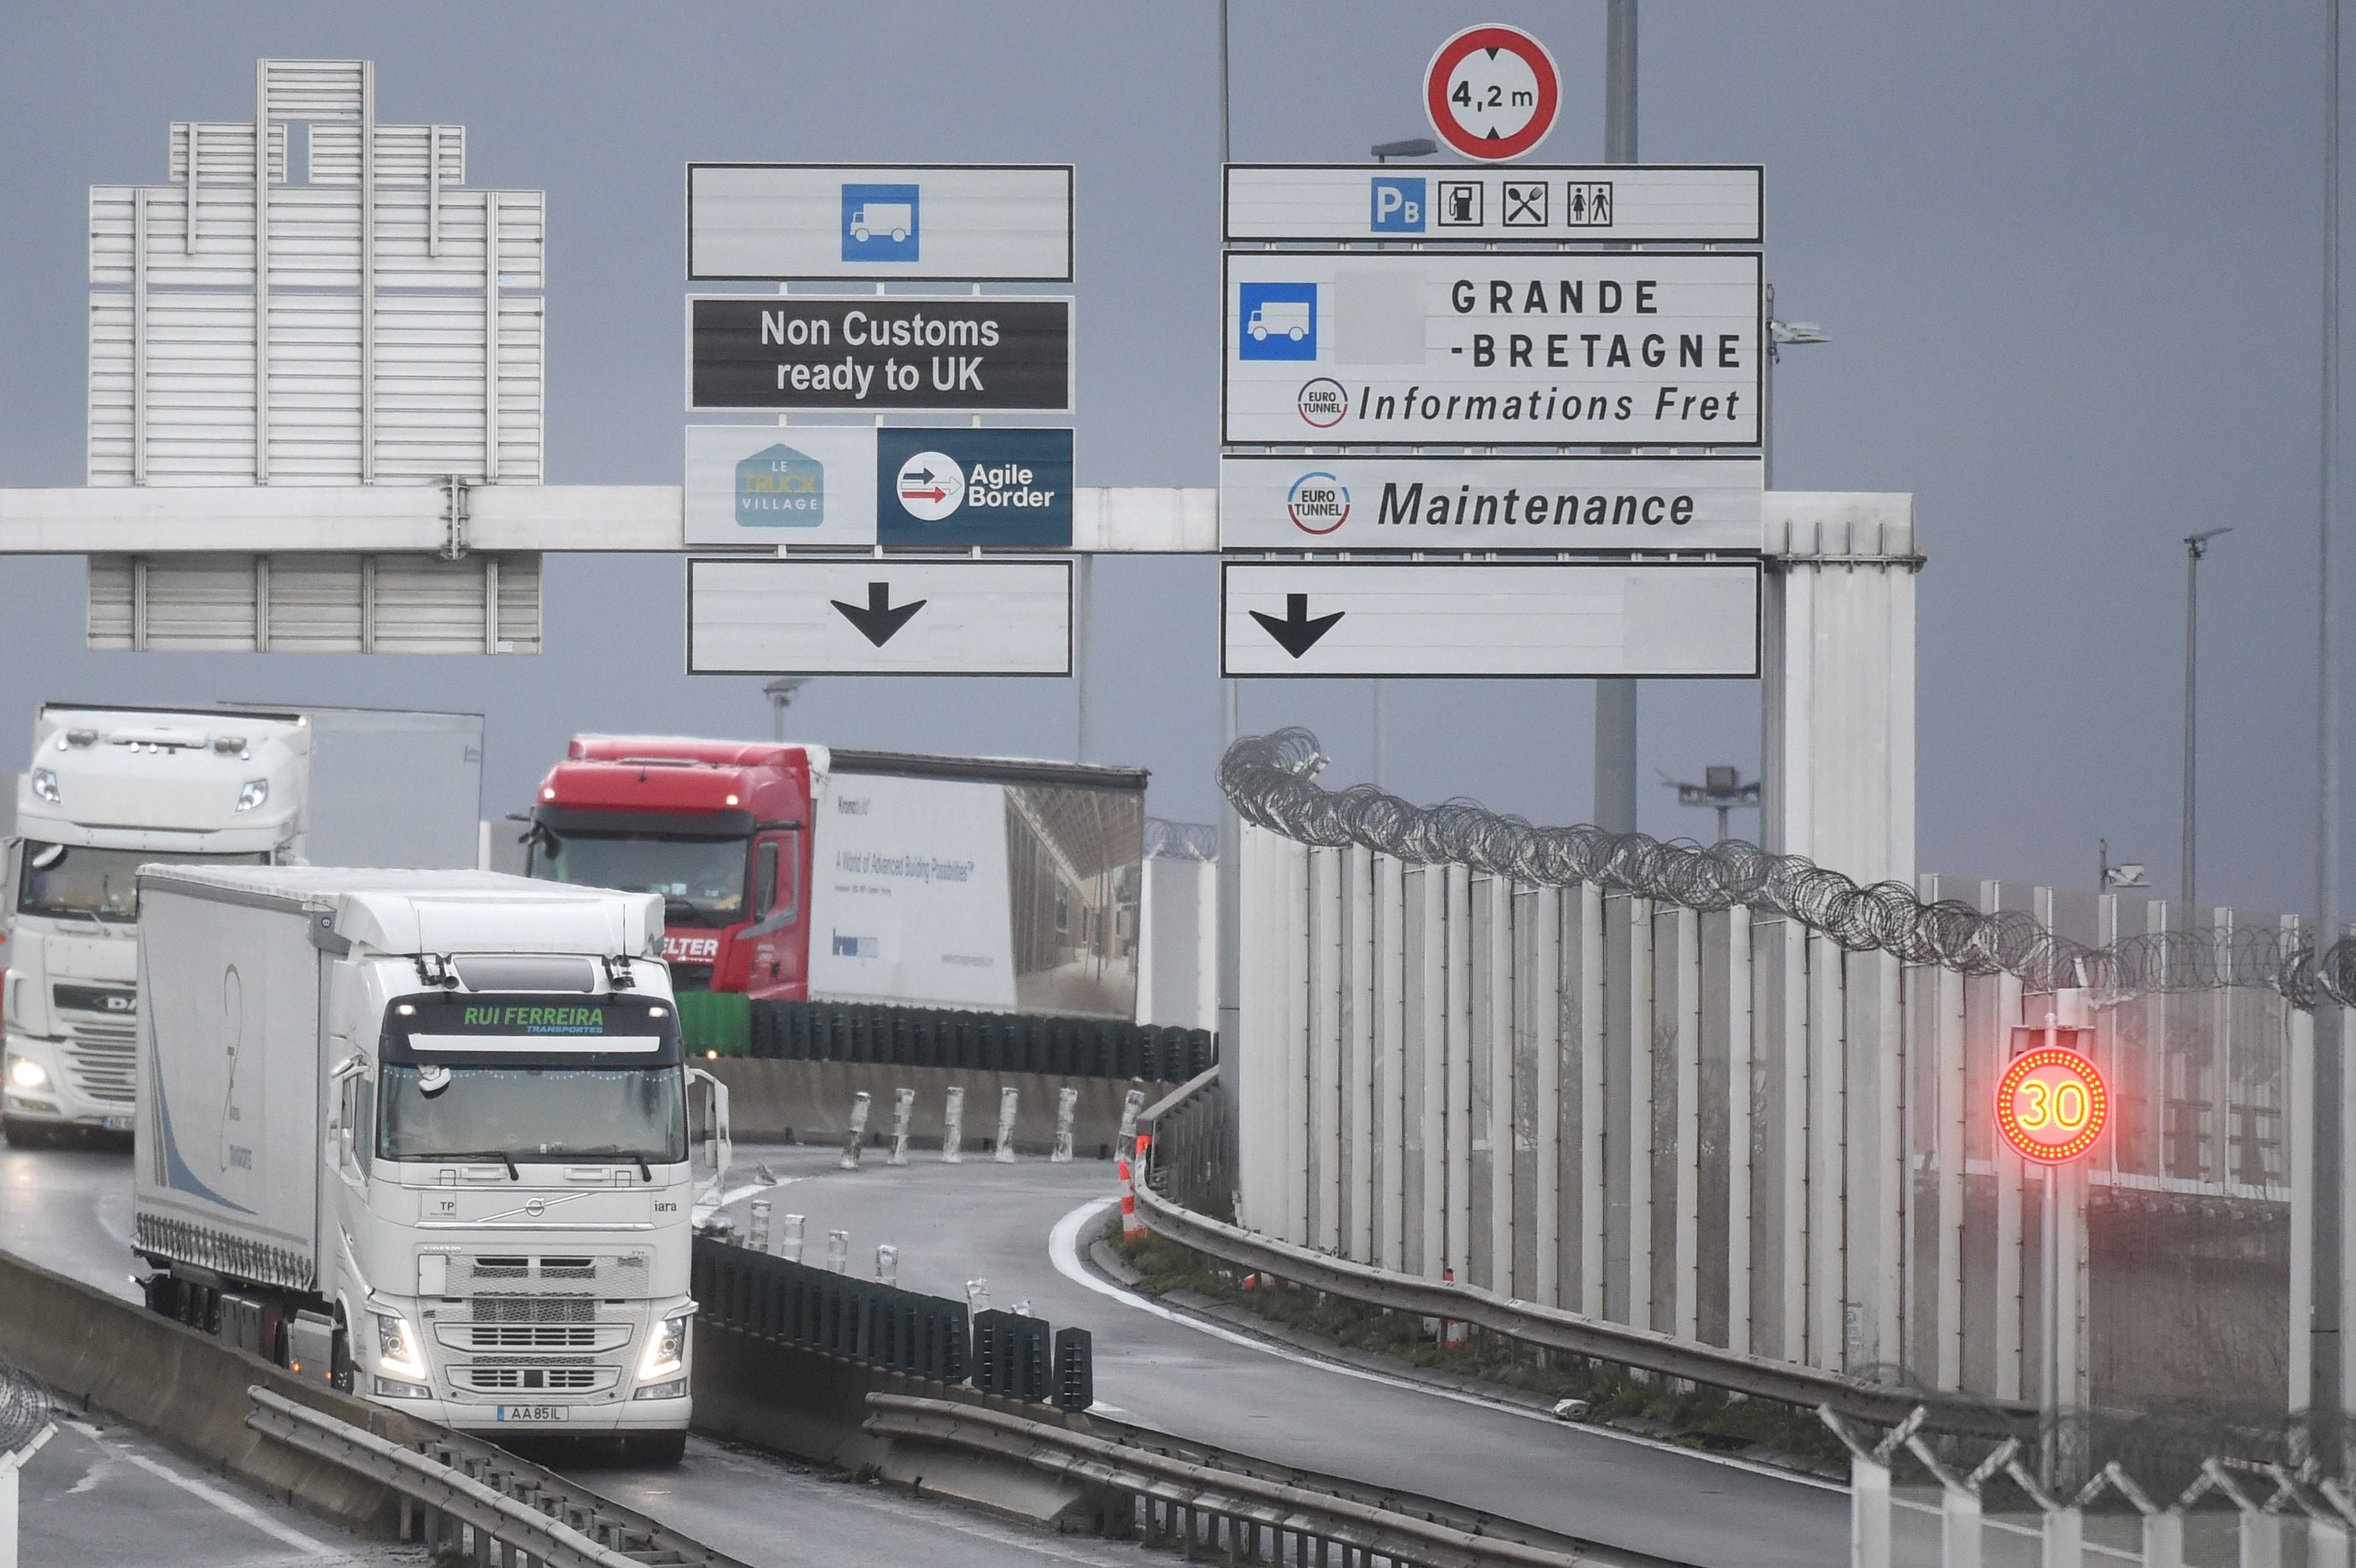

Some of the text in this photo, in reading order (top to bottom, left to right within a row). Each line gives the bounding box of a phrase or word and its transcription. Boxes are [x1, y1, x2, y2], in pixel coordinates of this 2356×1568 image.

[1452, 81, 1533, 112] 4,2 m
[1453, 280, 1658, 313] GRANDE
[762, 310, 1000, 347] Non Customs
[778, 356, 984, 399] ready to UK
[1308, 392, 1336, 402] EURO
[1359, 386, 1739, 420] Informations Fret
[1303, 403, 1342, 413] TUNNEL
[772, 461, 787, 472] LE
[970, 464, 1034, 486] Agile
[742, 498, 817, 511] VILLAGE
[969, 486, 1055, 507] Border
[1302, 490, 1336, 503] EURO
[1378, 483, 1694, 525] Maintenance
[1295, 504, 1342, 516] TUNNEL
[465, 1008, 604, 1025] RUI FERREIRA
[527, 1025, 604, 1034] TRANSPORTES
[2017, 1079, 2088, 1131] 30
[440, 1202, 454, 1211] TP
[654, 1201, 677, 1212] iara
